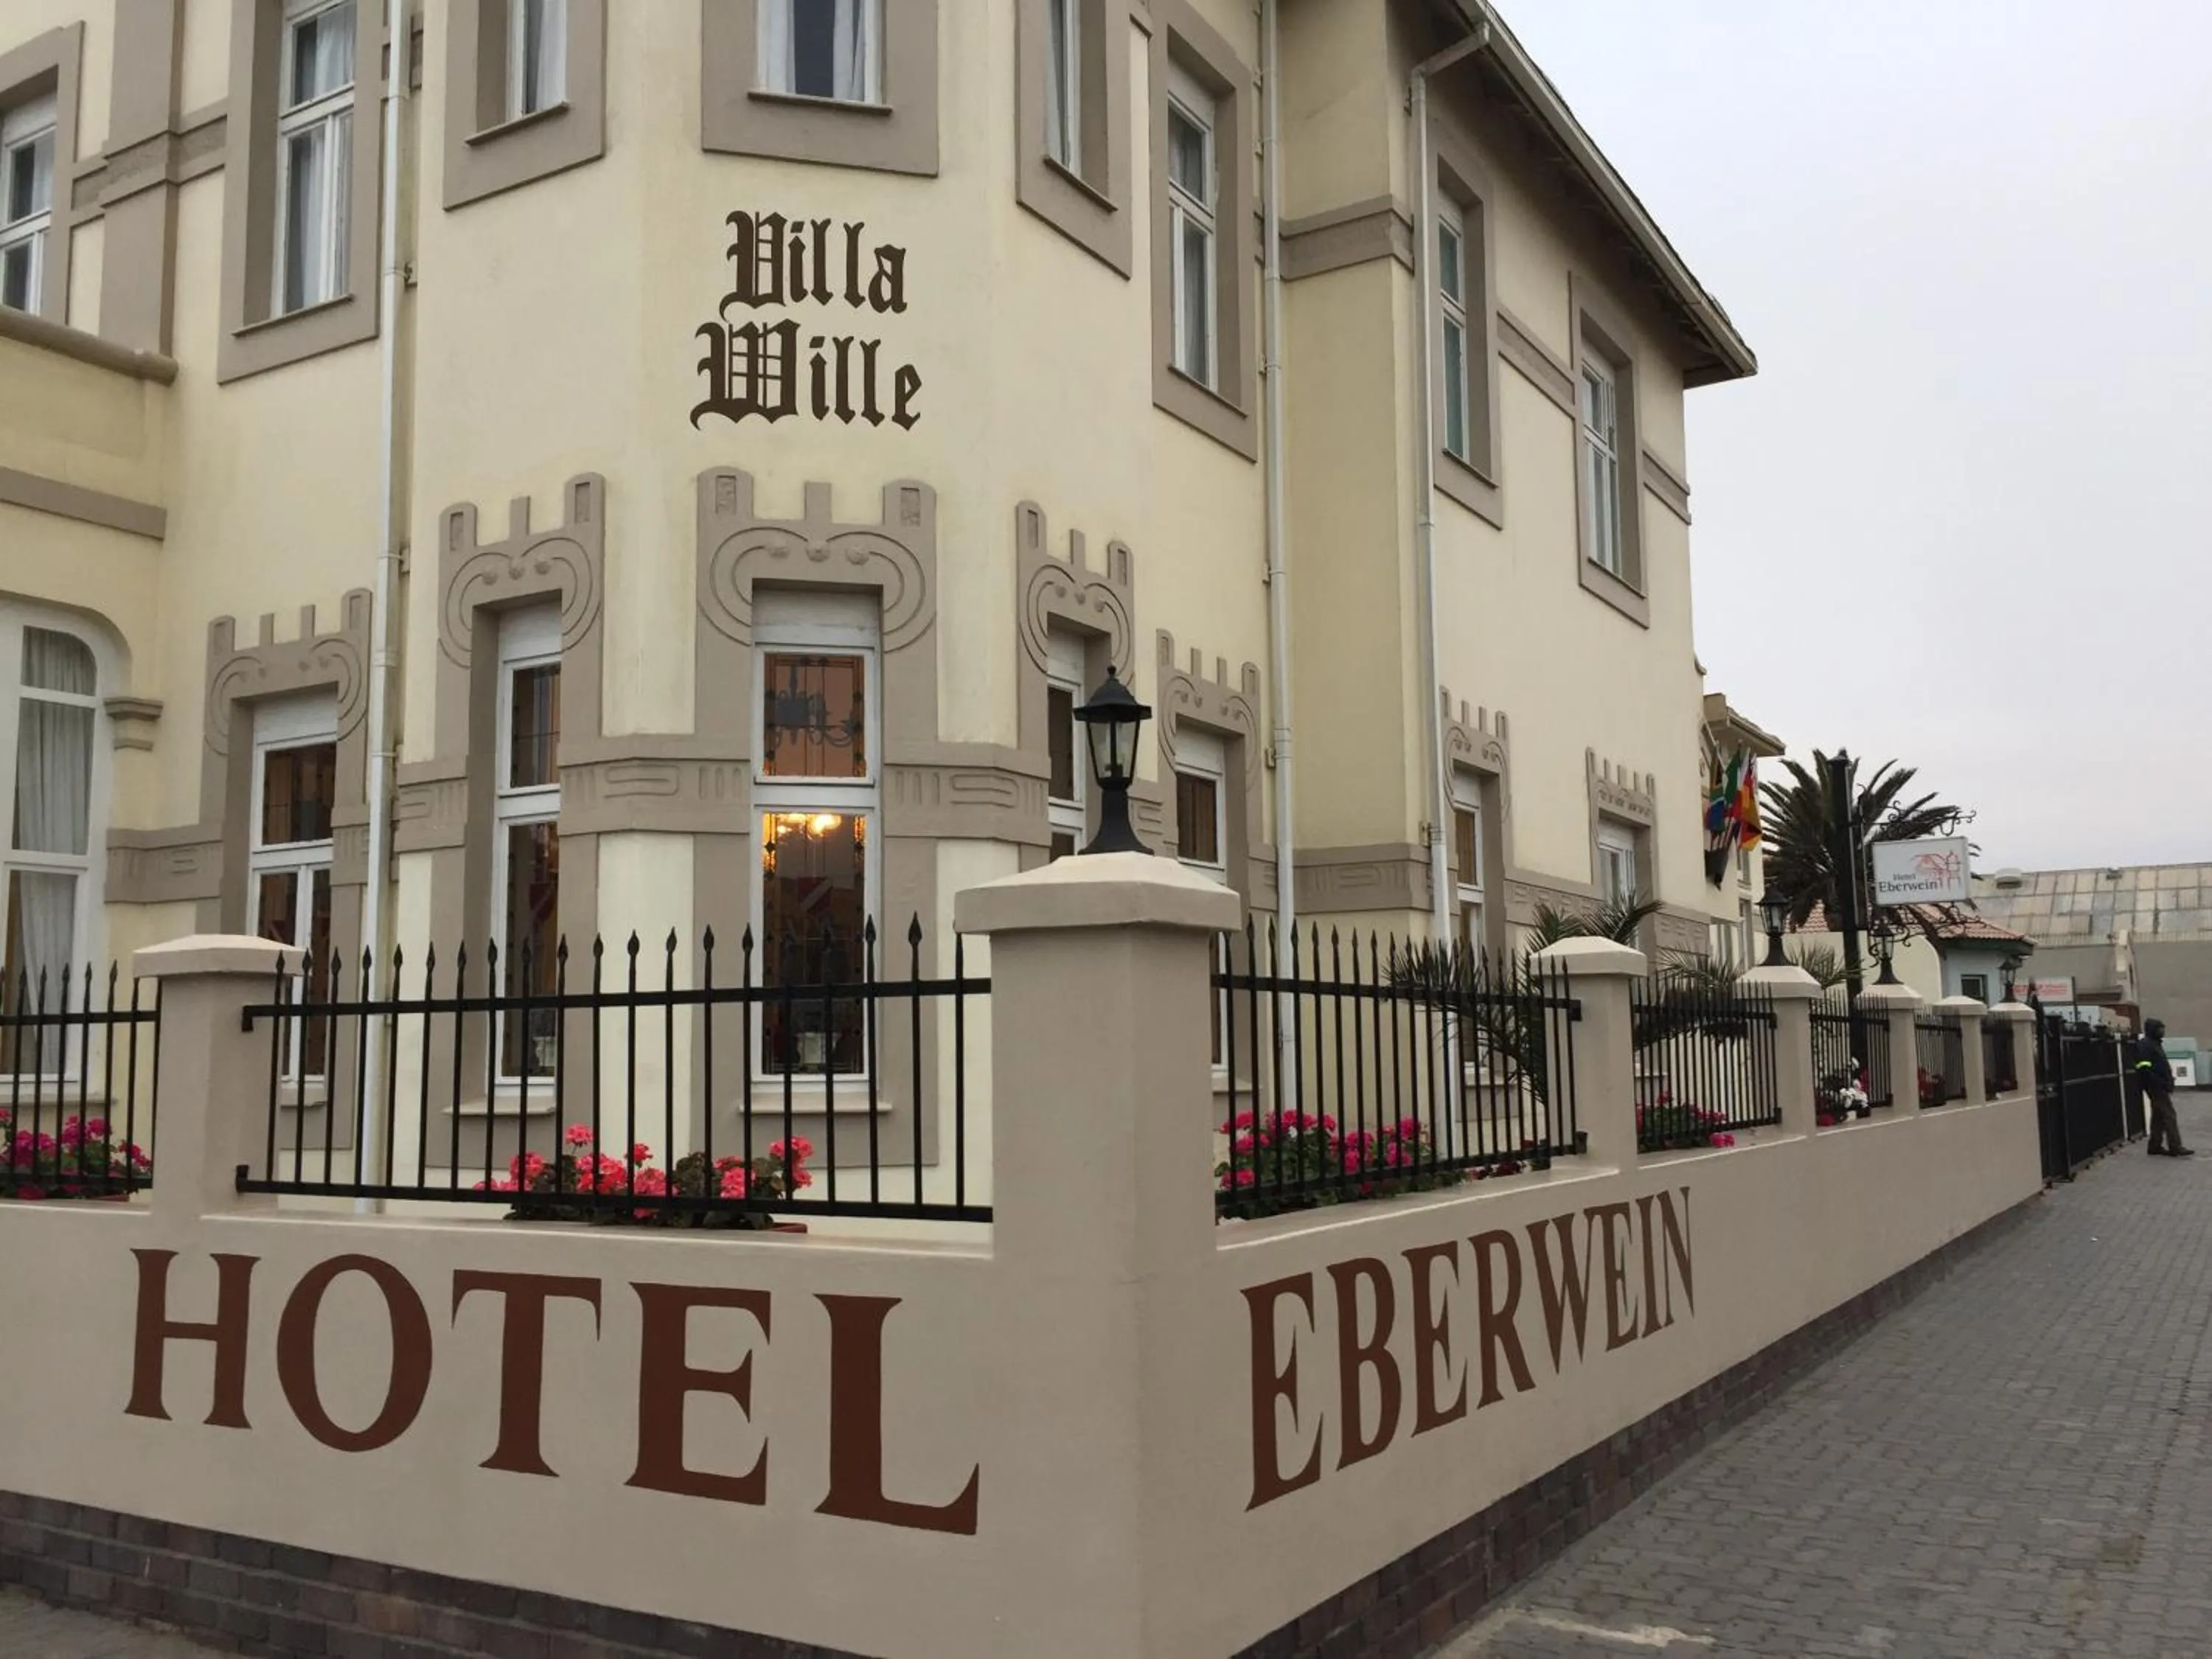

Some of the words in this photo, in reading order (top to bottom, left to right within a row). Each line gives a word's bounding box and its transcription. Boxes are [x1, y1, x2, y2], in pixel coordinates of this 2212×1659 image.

[719, 210, 908, 322] Villa
[689, 318, 922, 431] Wille
[1879, 880, 1938, 893] Eberwein
[123, 1248, 979, 1535] HOTEL
[1240, 1186, 1694, 1512] EBERWEIN
